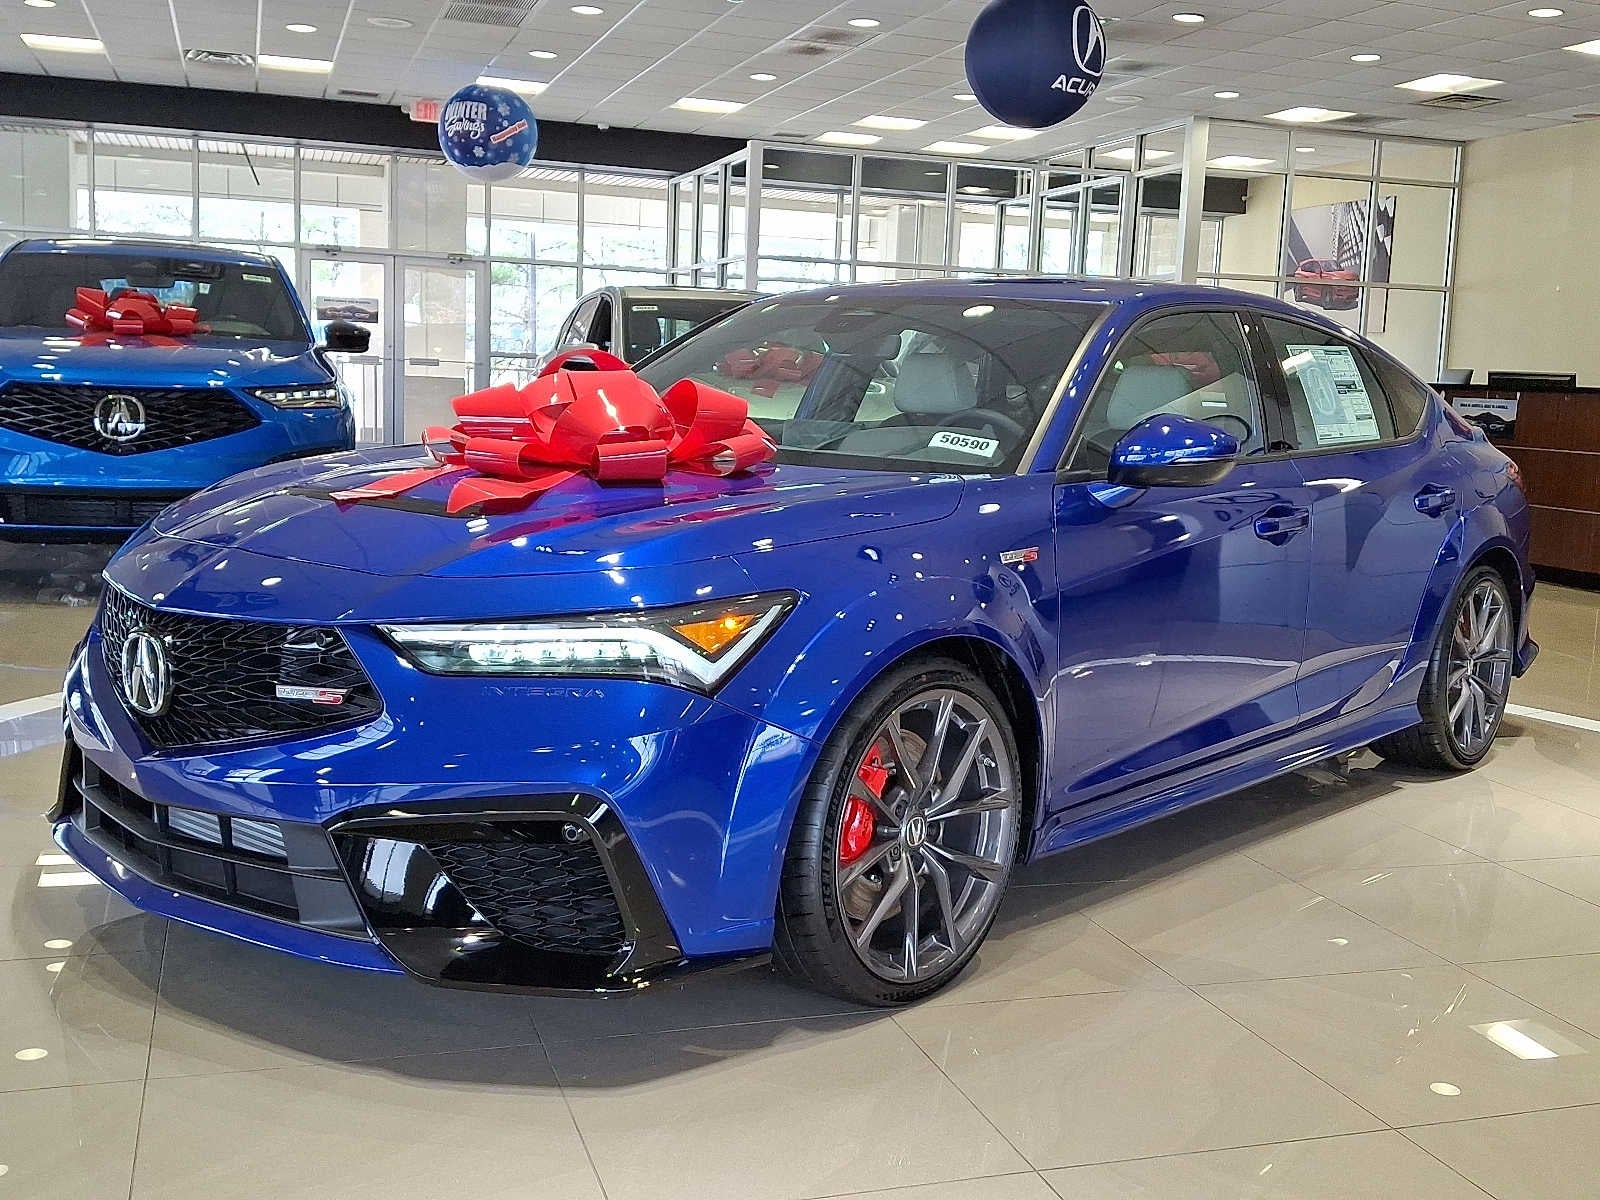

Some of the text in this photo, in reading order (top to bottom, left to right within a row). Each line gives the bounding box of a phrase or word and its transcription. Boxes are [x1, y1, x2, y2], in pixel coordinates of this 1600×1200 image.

[1050, 74, 1096, 97] ACUR
[445, 101, 487, 121] WINTER
[445, 117, 485, 139] Savings
[940, 434, 989, 451] 50590
[482, 686, 604, 698] INTEGRA
